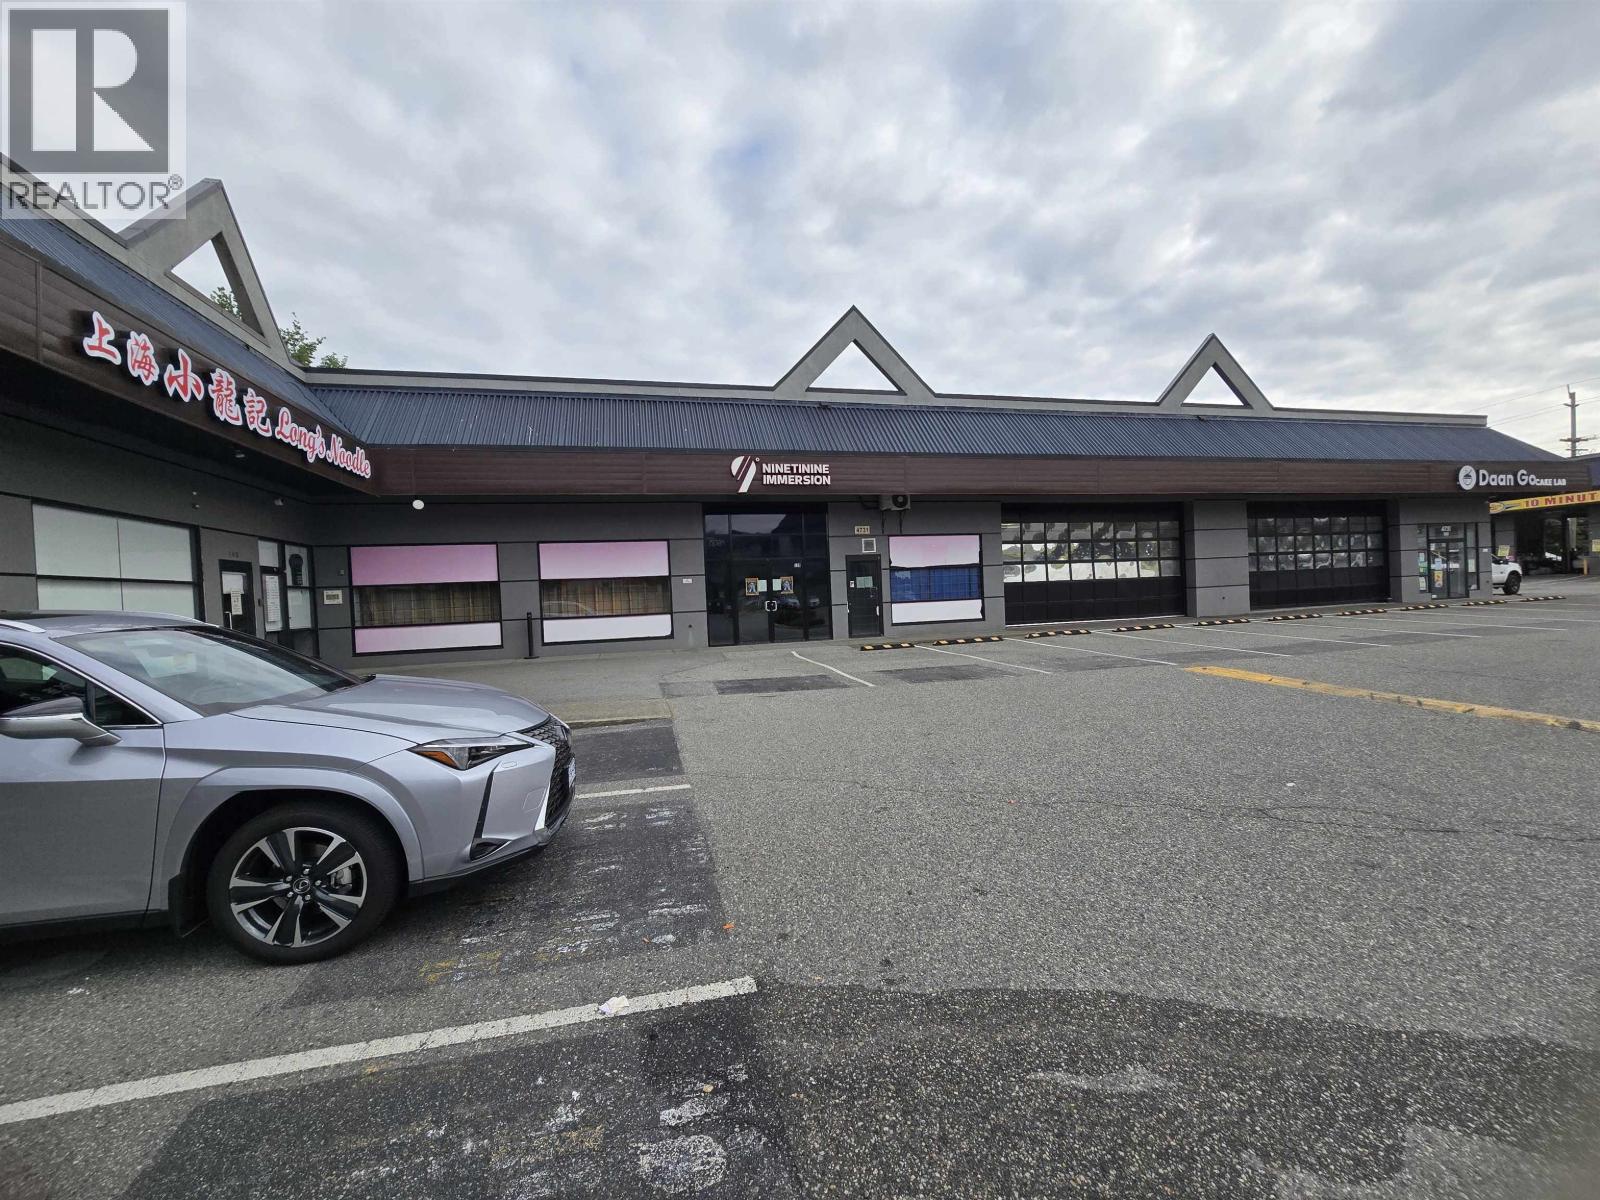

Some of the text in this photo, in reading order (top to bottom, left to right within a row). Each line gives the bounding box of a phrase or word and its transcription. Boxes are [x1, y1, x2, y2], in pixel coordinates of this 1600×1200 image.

[83, 311, 272, 437] 上海小龍記
[275, 407, 372, 479] Long's Noodle
[762, 463, 830, 474] NINETININE
[763, 475, 831, 485] IMMERSION
[1479, 469, 1514, 486] Daan
[1517, 469, 1536, 485] Go
[1524, 499, 1539, 508] 10
